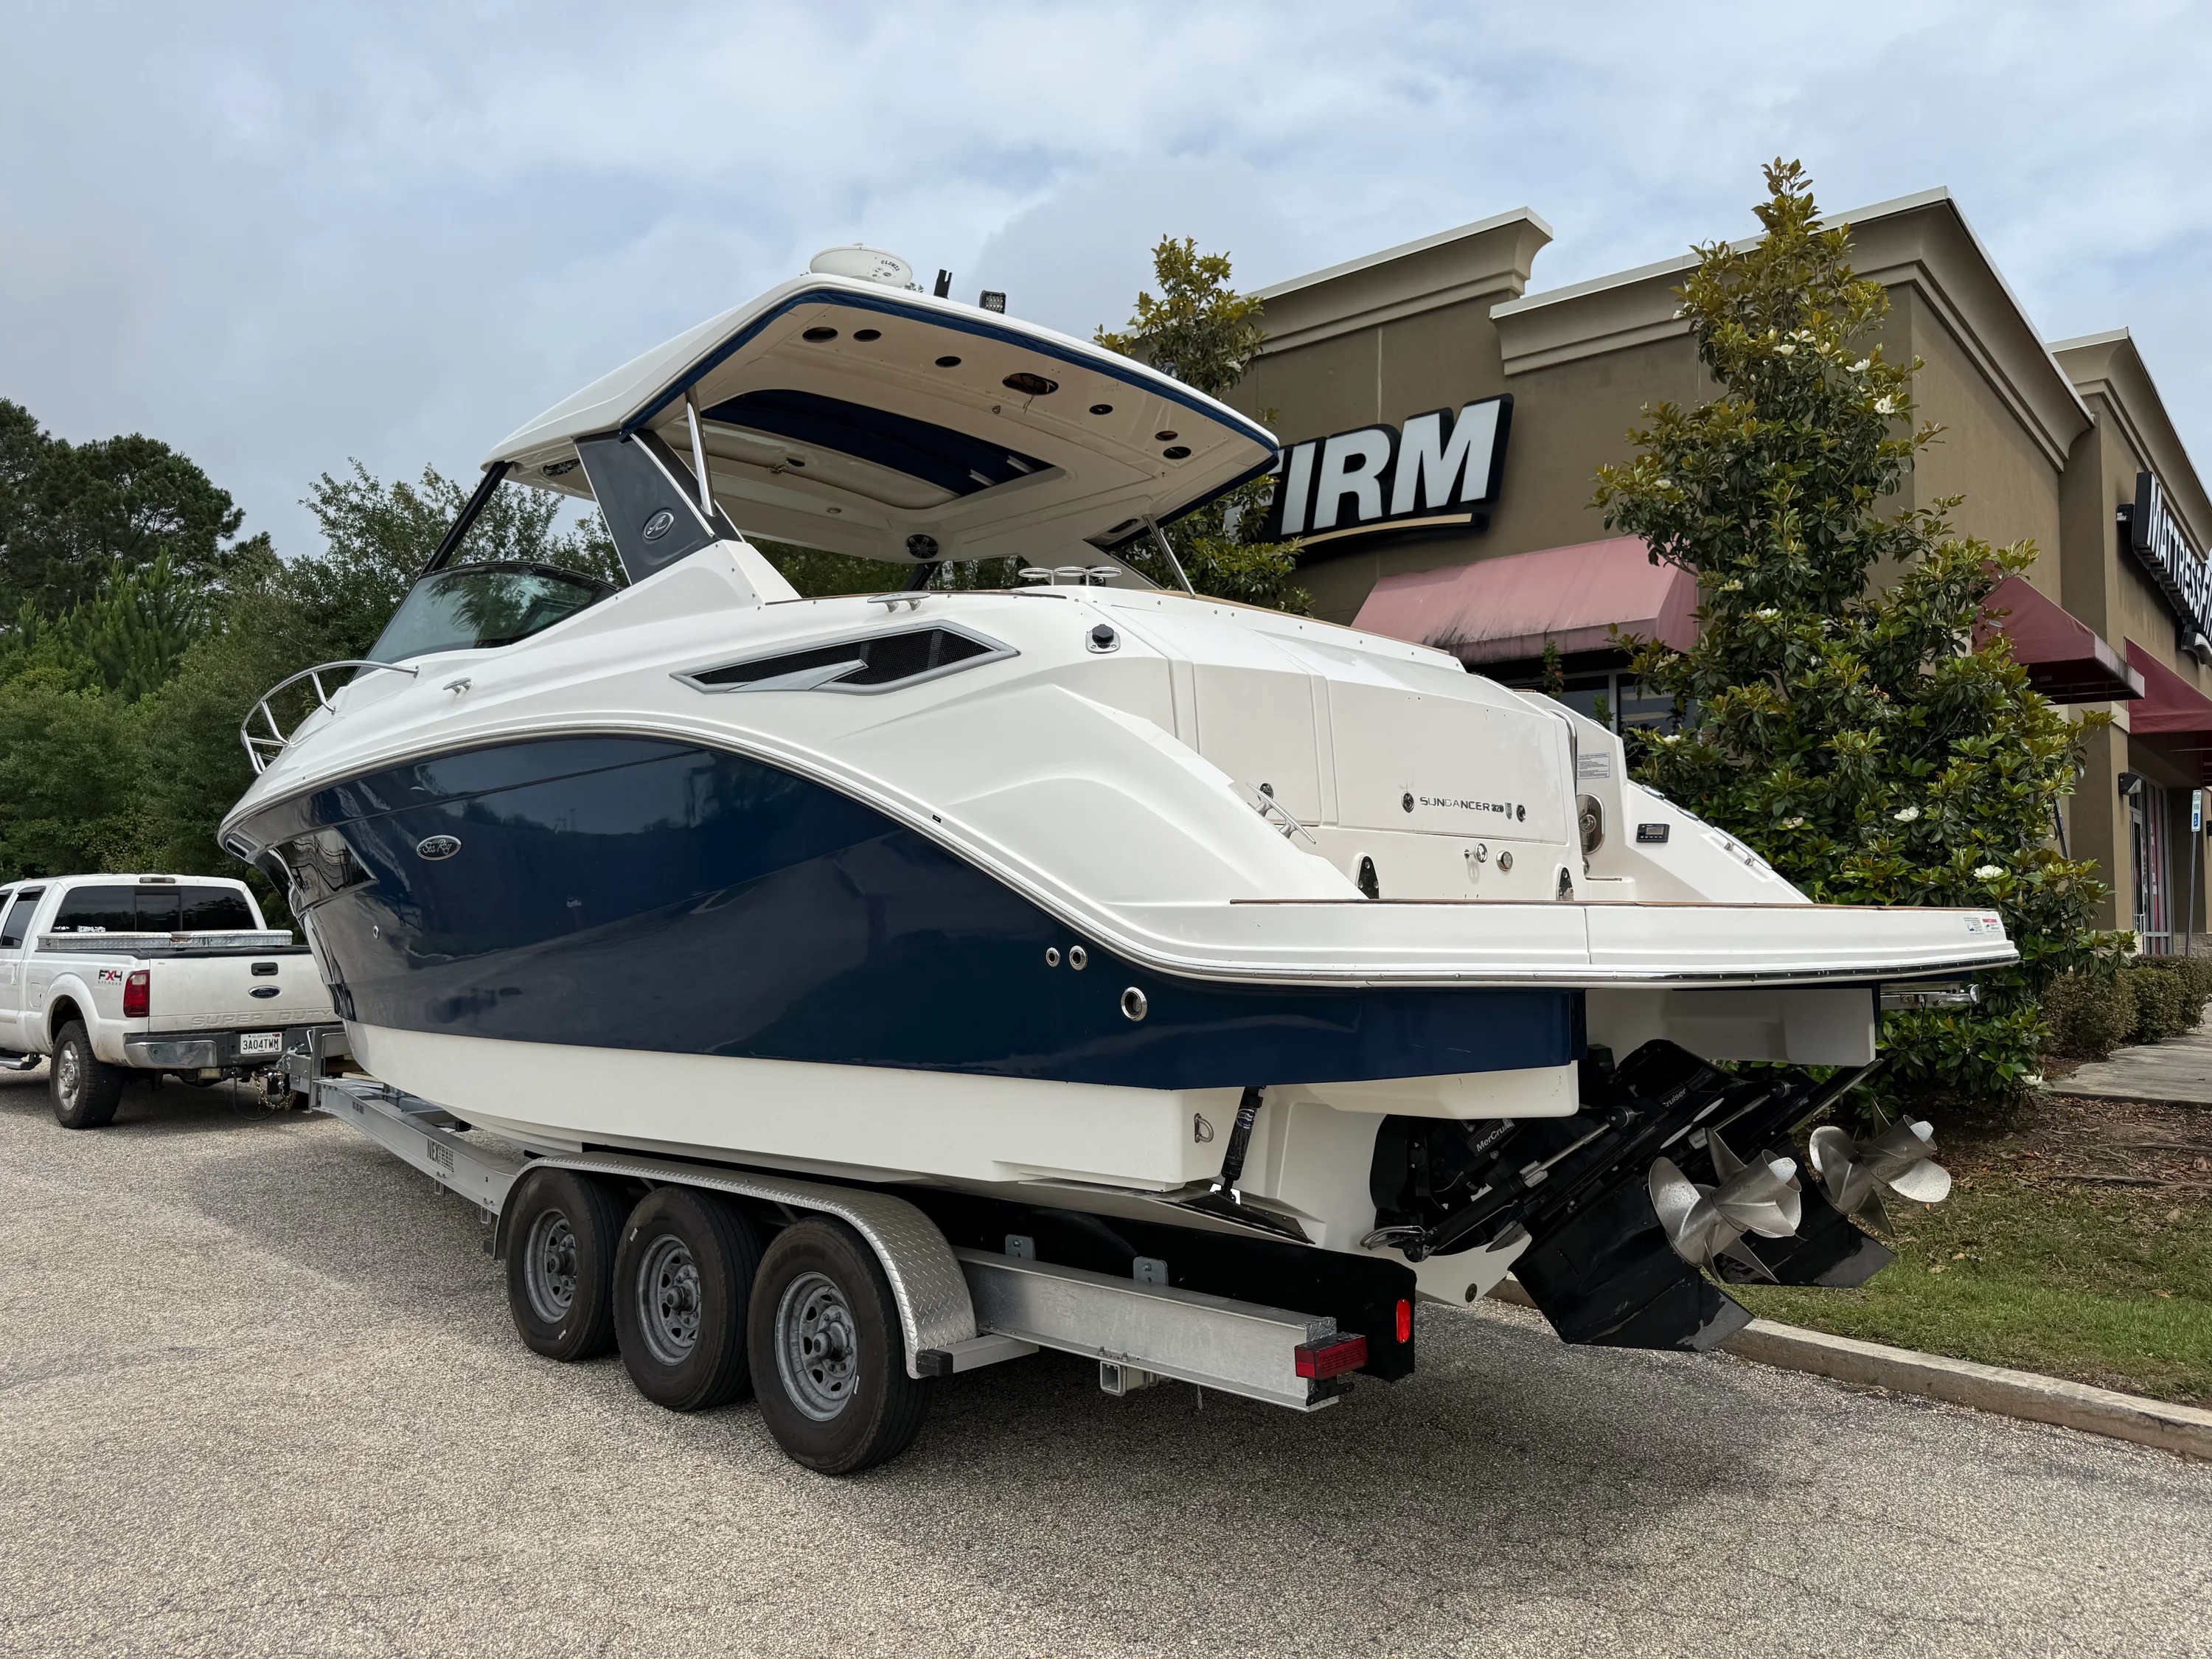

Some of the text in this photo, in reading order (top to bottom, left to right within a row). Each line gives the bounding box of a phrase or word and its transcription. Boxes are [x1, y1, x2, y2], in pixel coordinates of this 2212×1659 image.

[1419, 796, 1490, 811] SUNDANCER
[422, 838, 453, 855] Sea Ray
[98, 969, 123, 981] FX4
[191, 1009, 331, 1027] SUPER DUTY
[243, 1038, 279, 1050] 3A04TWM
